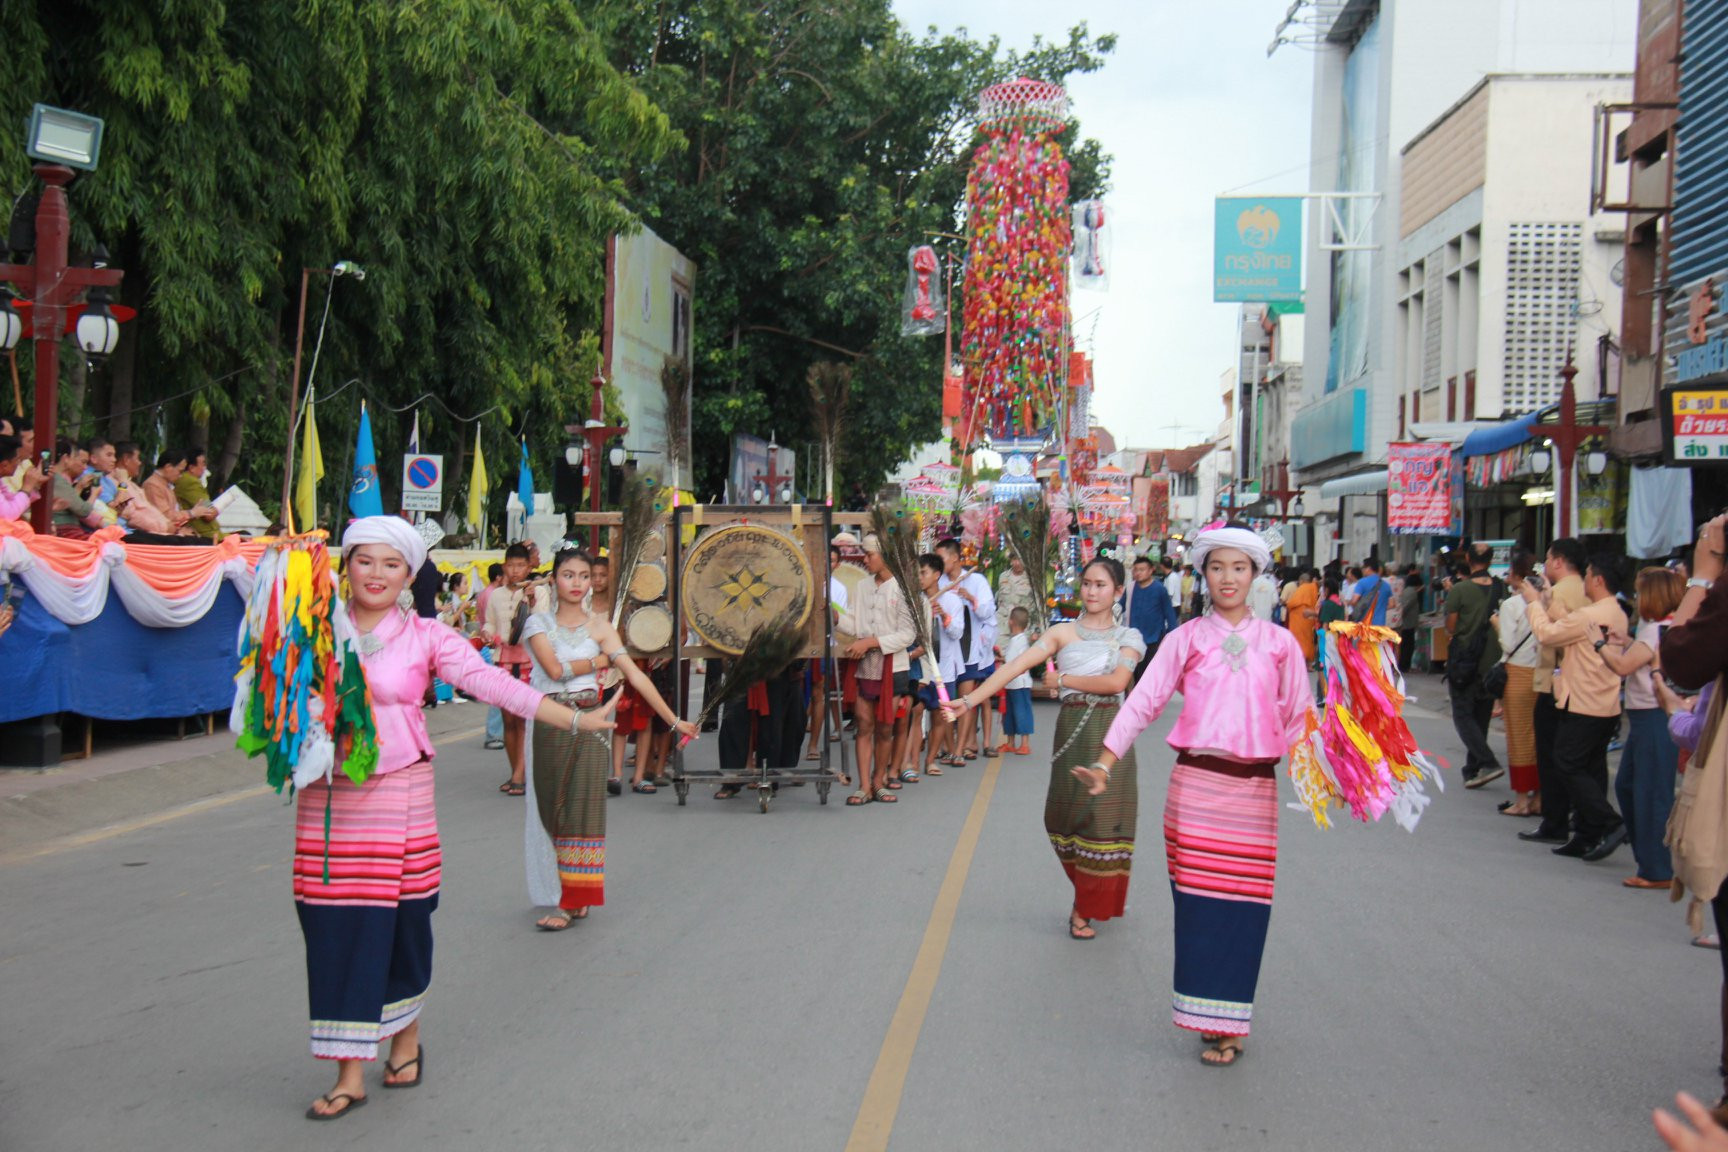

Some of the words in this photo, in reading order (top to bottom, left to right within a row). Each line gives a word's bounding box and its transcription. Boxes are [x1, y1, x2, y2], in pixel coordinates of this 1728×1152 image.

[1225, 251, 1291, 272] กรุงไทย
[1683, 440, 1708, 457] ส่ง
